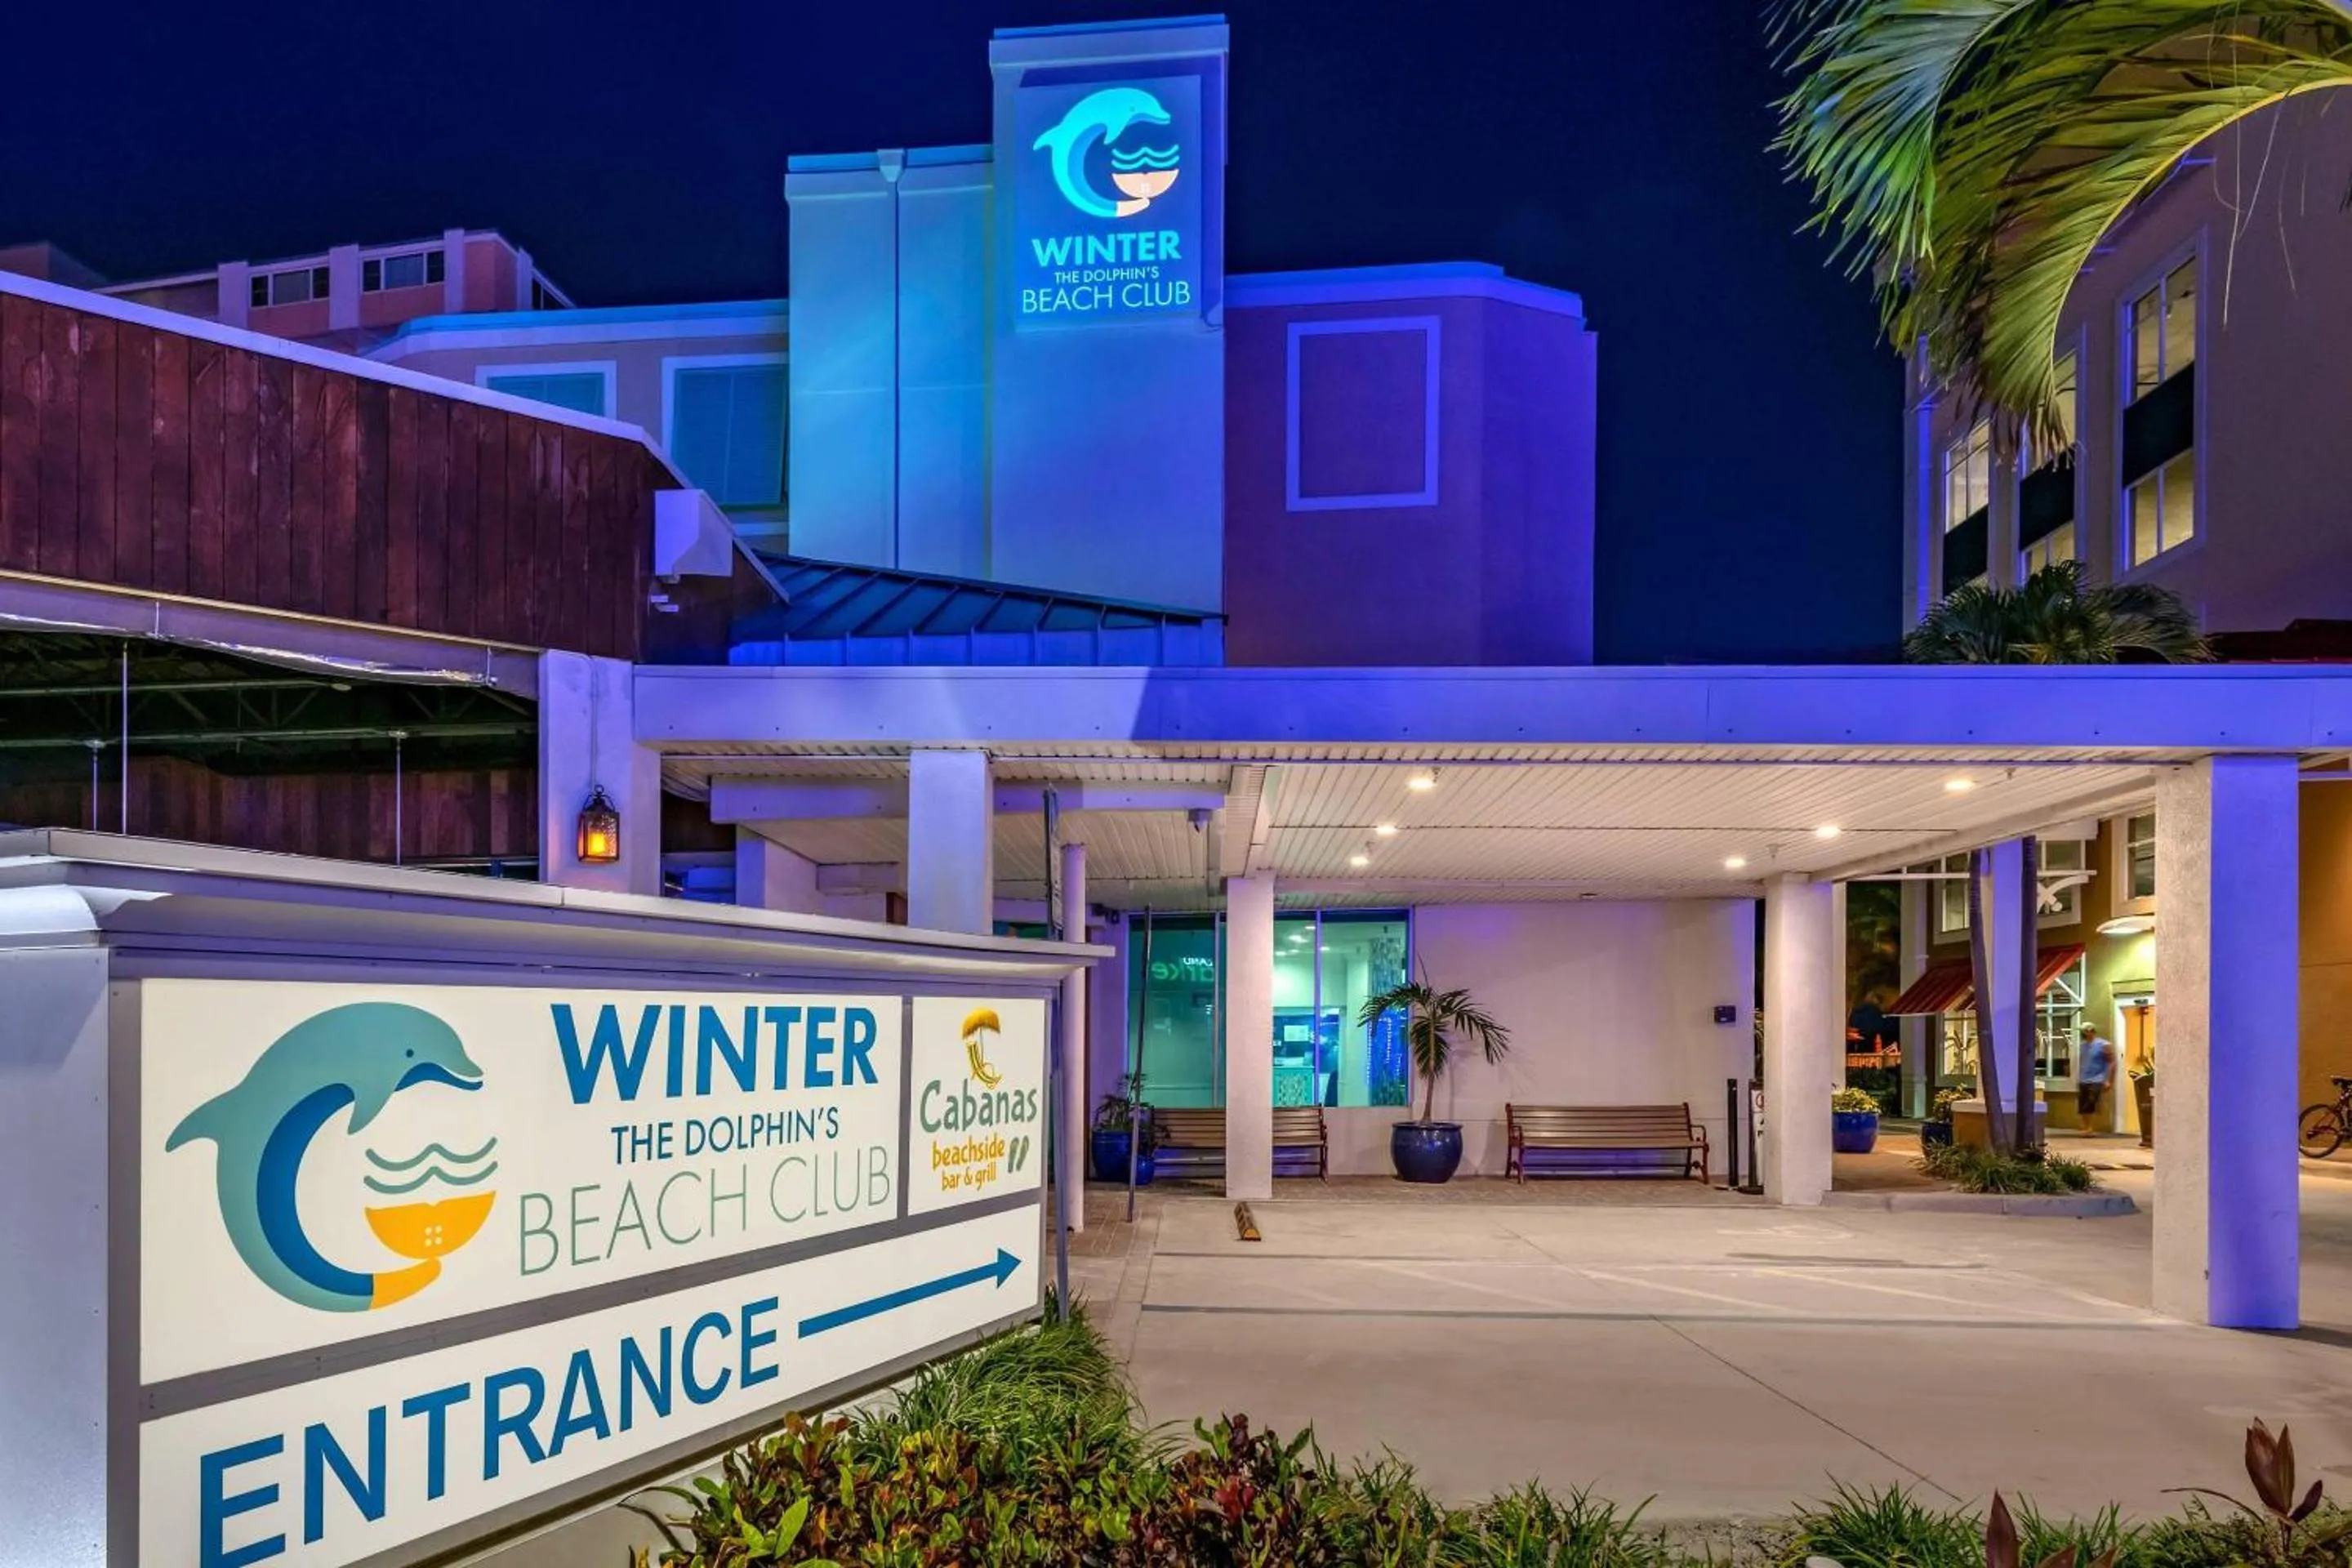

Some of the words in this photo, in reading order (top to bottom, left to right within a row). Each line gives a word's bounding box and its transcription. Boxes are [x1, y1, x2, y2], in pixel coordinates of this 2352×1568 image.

[1031, 230, 1182, 267] WINTER
[1022, 285, 1112, 314] BEACH
[1122, 281, 1191, 307] CLUB
[1054, 270, 1080, 284] THE
[1084, 265, 1160, 283] DOLPHIN'S
[550, 1003, 879, 1105] WINTER
[920, 1078, 1038, 1134] Cabanas
[610, 1121, 674, 1165] THE
[685, 1106, 840, 1156] DOLPHIN'S
[932, 1132, 1005, 1171] beachside
[942, 1169, 961, 1191] bar
[964, 1165, 973, 1187] &
[975, 1161, 996, 1192] grill
[519, 1163, 747, 1276] BEACH
[769, 1145, 891, 1223] CLUB
[199, 1295, 780, 1568] ENTRANCE
